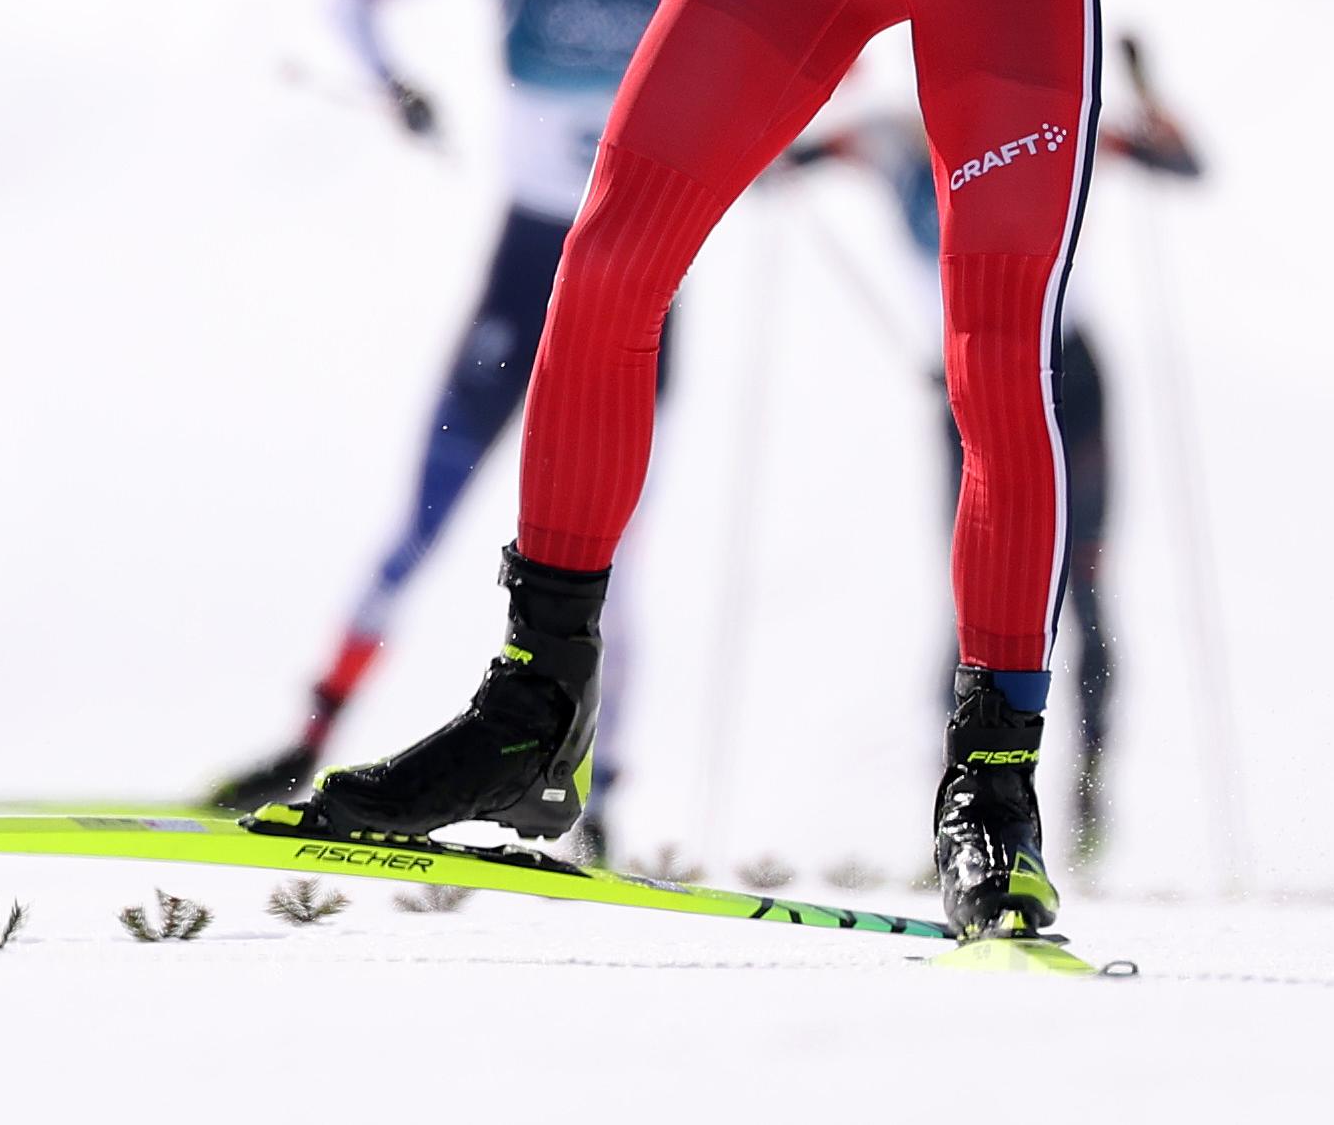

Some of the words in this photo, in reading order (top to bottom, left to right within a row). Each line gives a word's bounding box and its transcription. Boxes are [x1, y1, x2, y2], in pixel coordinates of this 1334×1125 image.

[950, 132, 1040, 191] CRAFT
[967, 749, 1040, 765] FISCH
[294, 843, 435, 873] FISCHER
